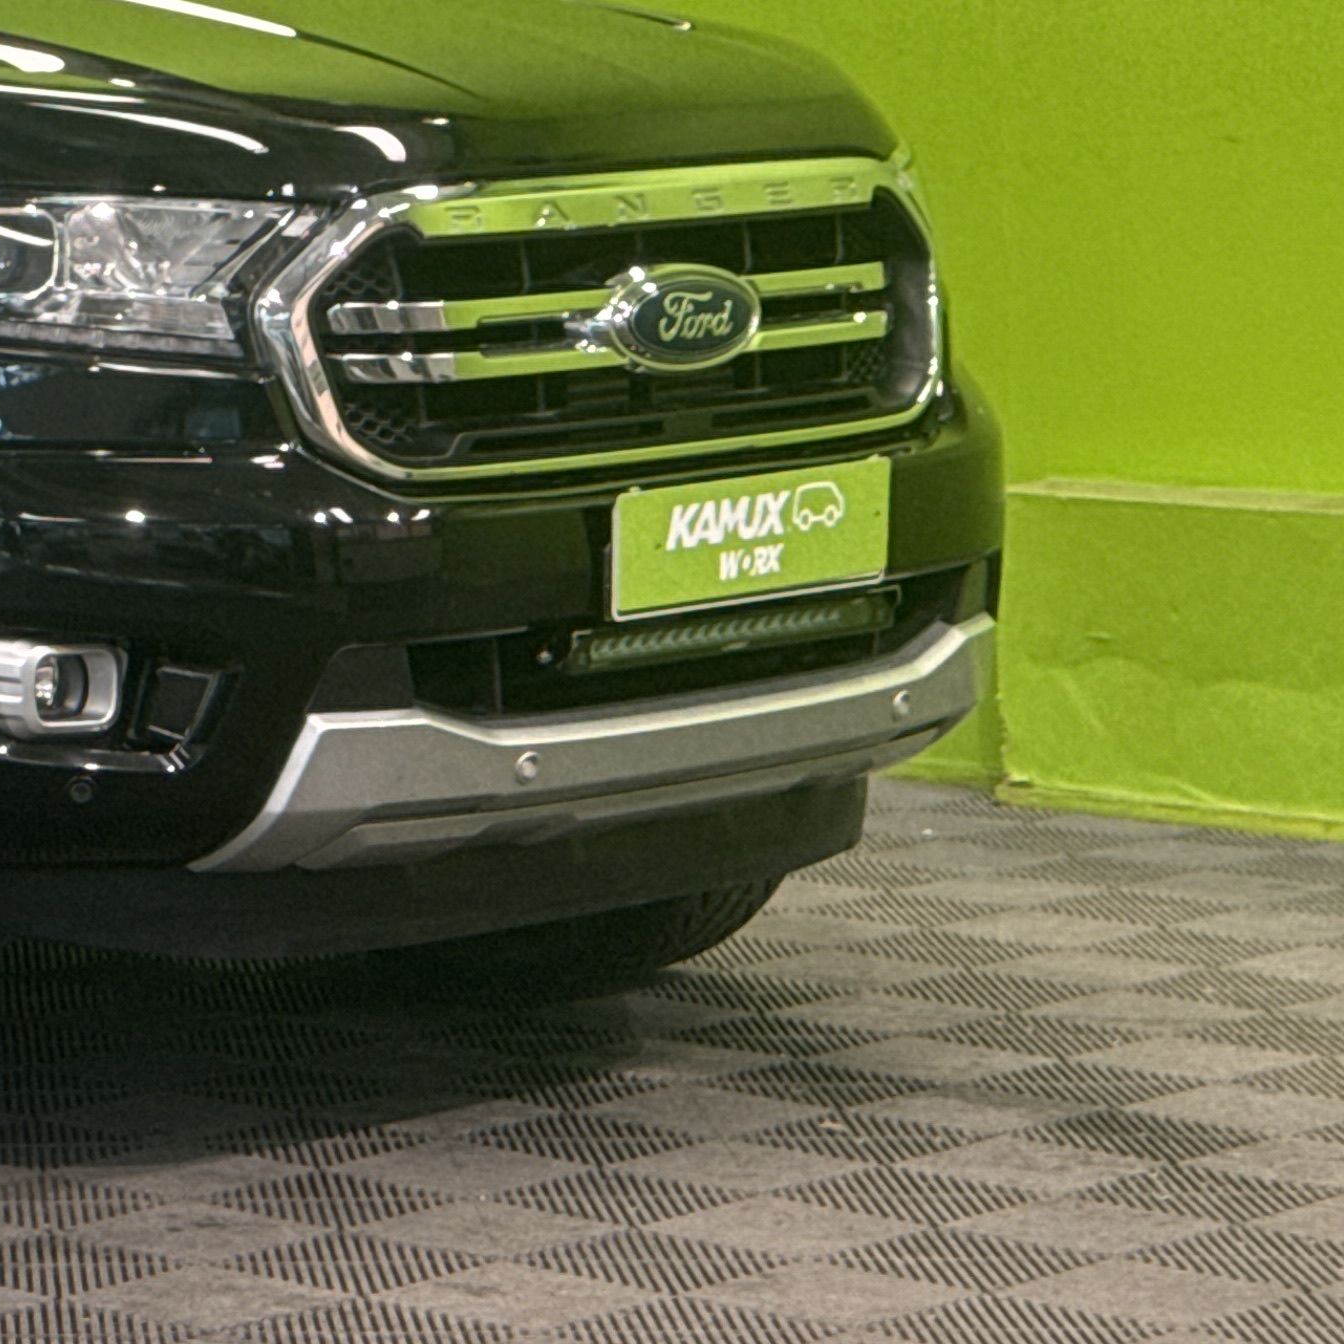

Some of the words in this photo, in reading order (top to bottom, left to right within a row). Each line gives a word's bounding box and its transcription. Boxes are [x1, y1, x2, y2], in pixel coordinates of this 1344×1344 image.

[444, 175, 858, 233] RANGER
[658, 290, 734, 343] Ford
[665, 489, 792, 552] KAMUX
[718, 542, 785, 581] WORX
